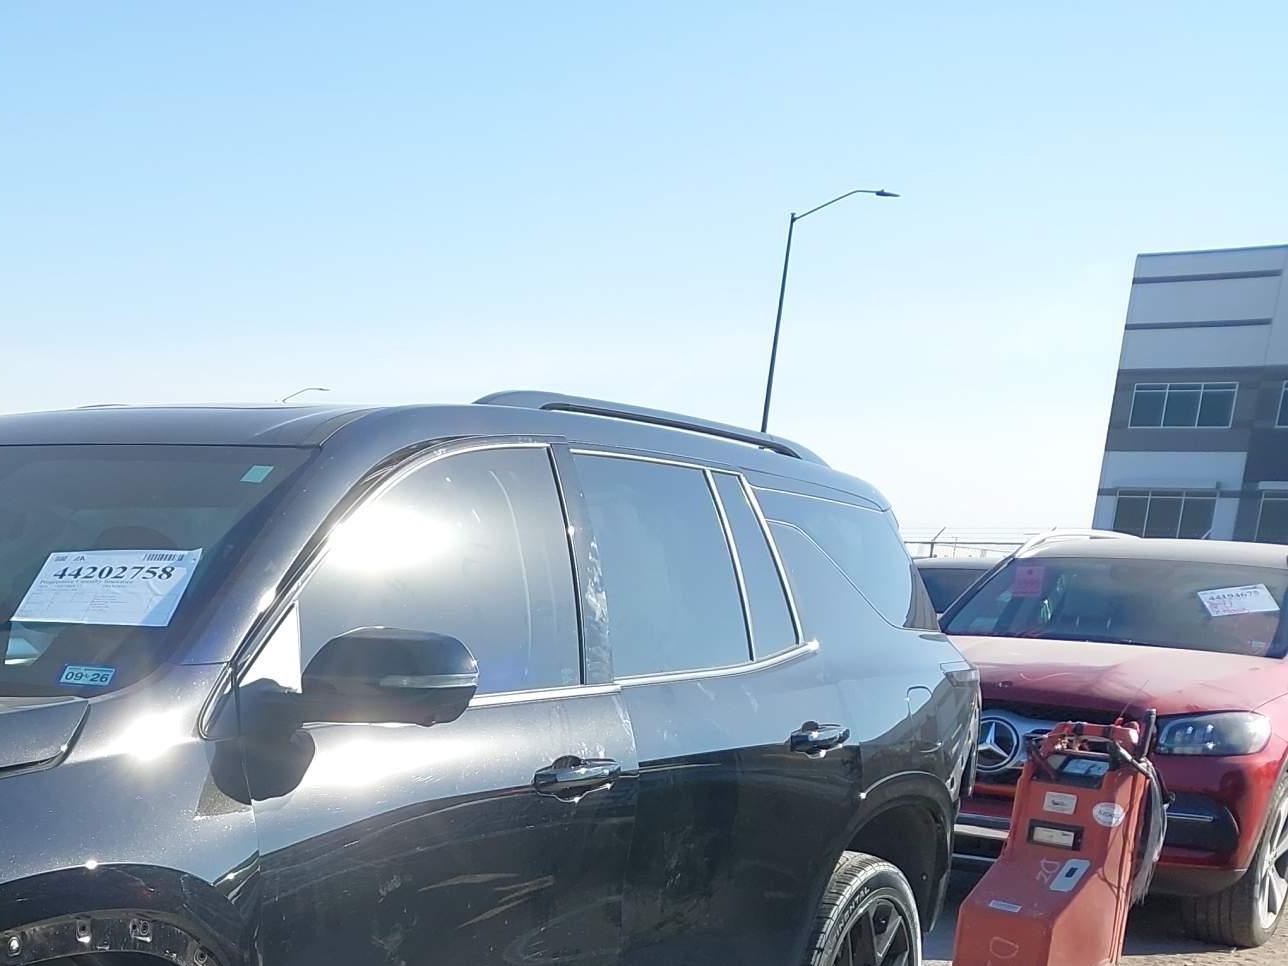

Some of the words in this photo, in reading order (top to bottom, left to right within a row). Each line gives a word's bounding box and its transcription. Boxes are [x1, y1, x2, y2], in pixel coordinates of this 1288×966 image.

[52, 565, 176, 580] 44202758
[65, 671, 83, 681] 09
[89, 672, 110, 683] 26
